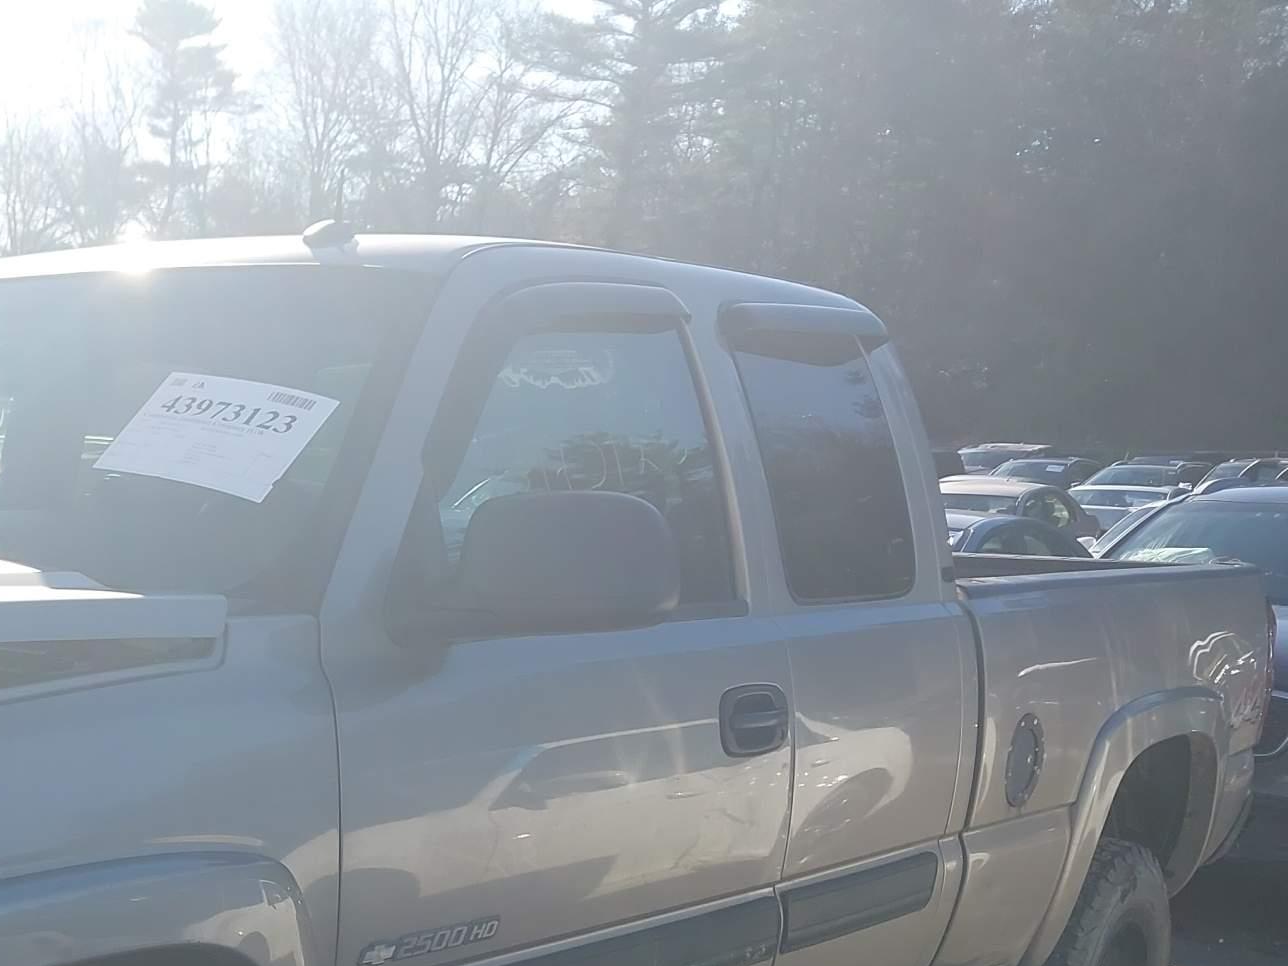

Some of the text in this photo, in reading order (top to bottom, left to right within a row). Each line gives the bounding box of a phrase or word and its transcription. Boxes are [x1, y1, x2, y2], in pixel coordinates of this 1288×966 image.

[160, 395, 297, 434] 43973123
[399, 920, 498, 957] 2500 HD
